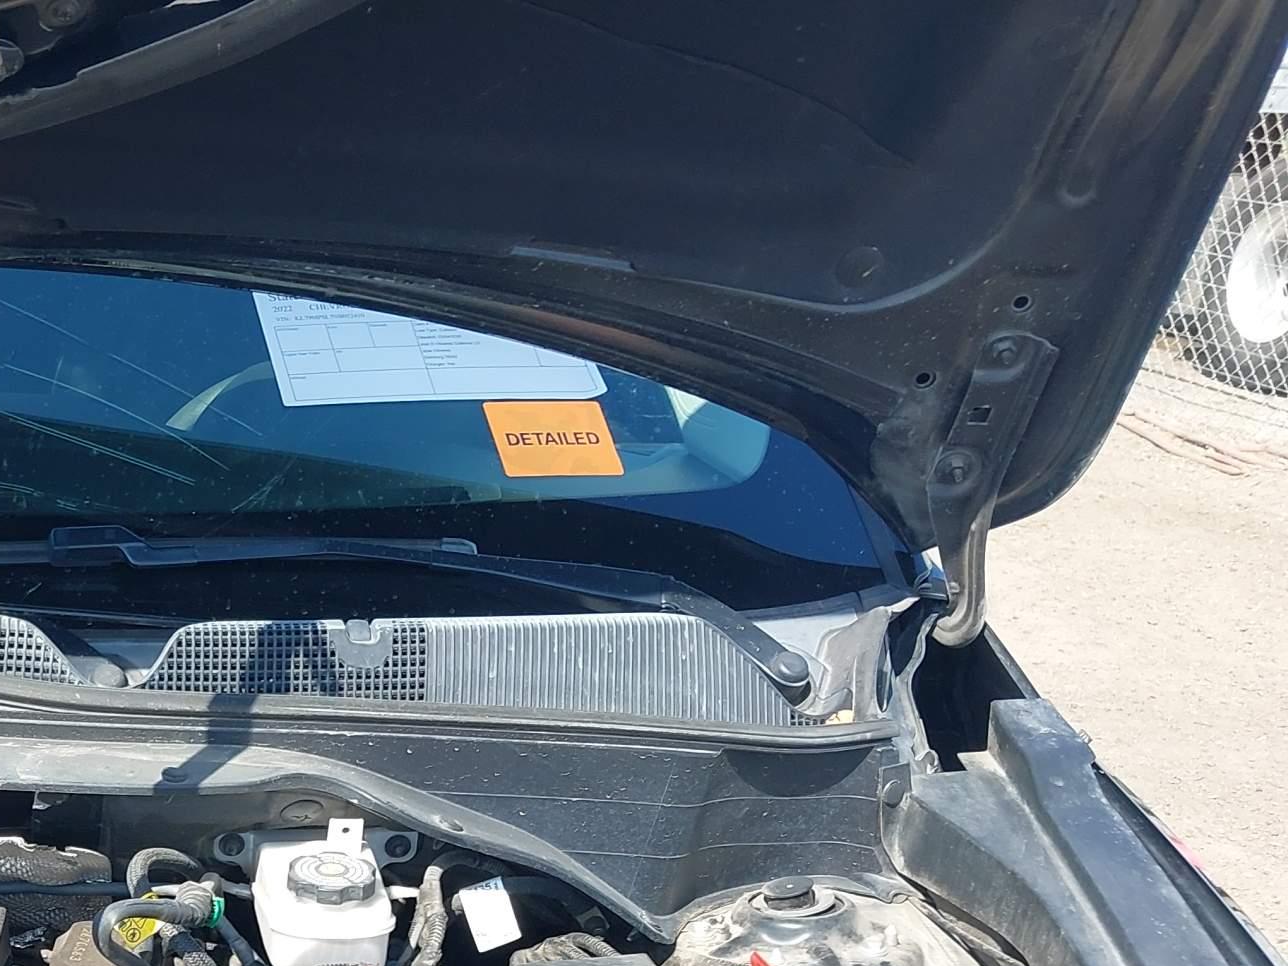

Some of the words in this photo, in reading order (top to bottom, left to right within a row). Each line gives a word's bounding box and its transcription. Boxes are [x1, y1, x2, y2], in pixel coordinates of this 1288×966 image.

[272, 304, 293, 313] 2022
[308, 303, 349, 312] CHEVR
[505, 432, 600, 446] DETAILED
